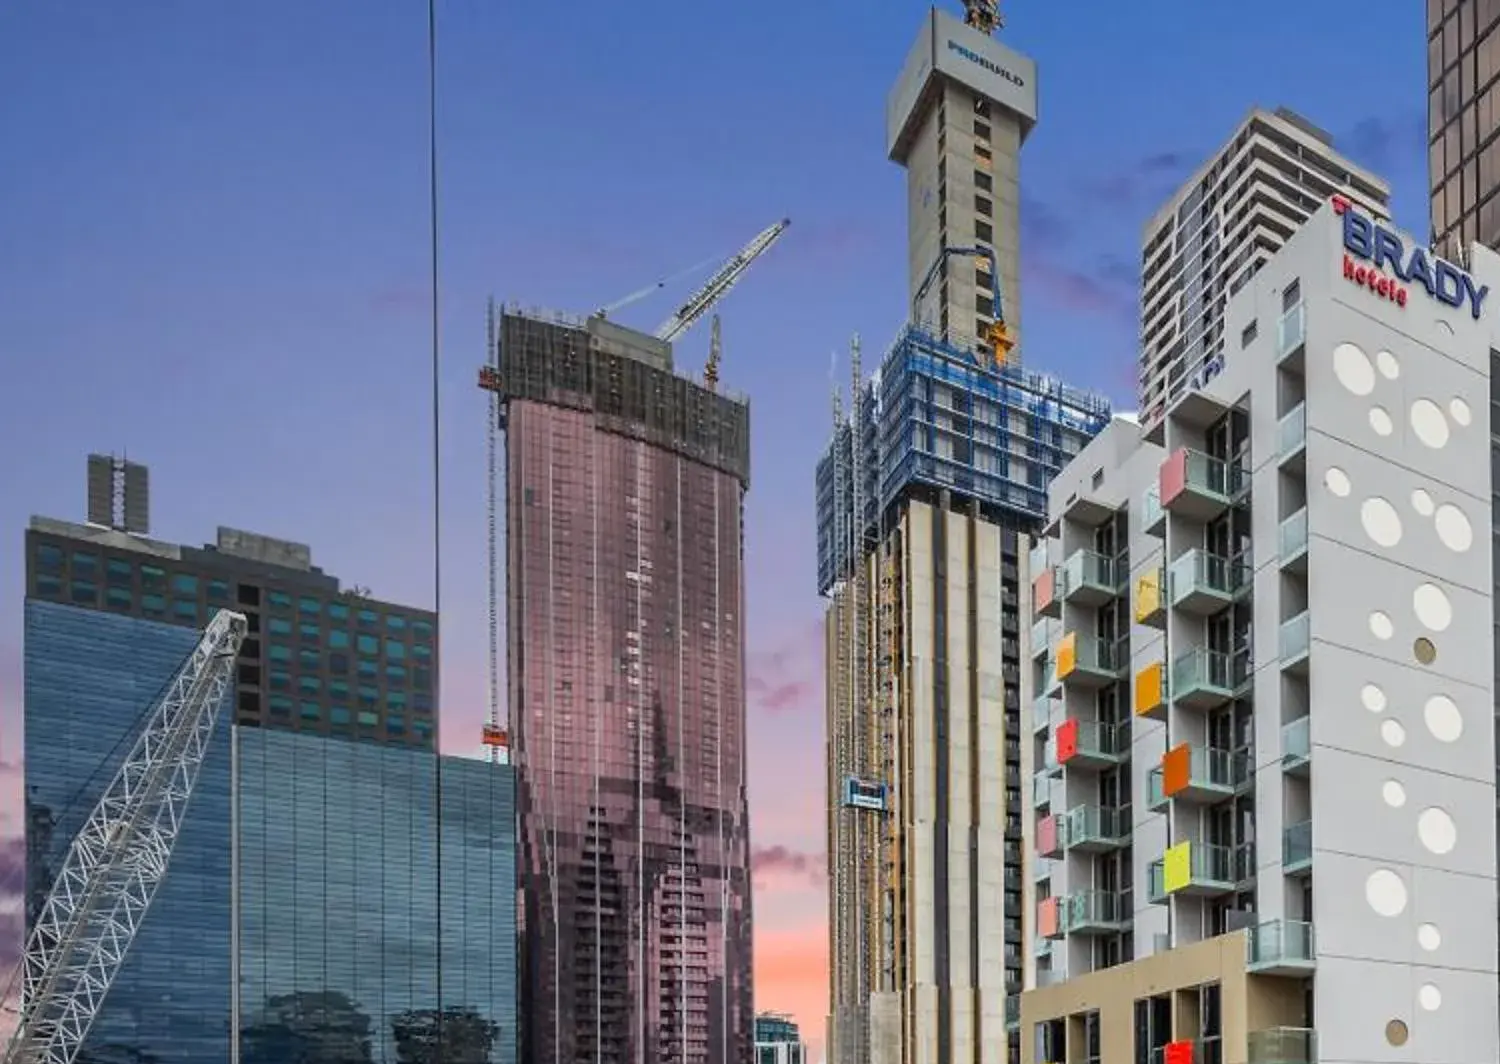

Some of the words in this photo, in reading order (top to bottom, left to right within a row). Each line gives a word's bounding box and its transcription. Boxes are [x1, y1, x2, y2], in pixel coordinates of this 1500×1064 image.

[947, 39, 1025, 87] PROBUILD
[1342, 253, 1408, 309] hotels
[1343, 206, 1489, 320] BRADY
